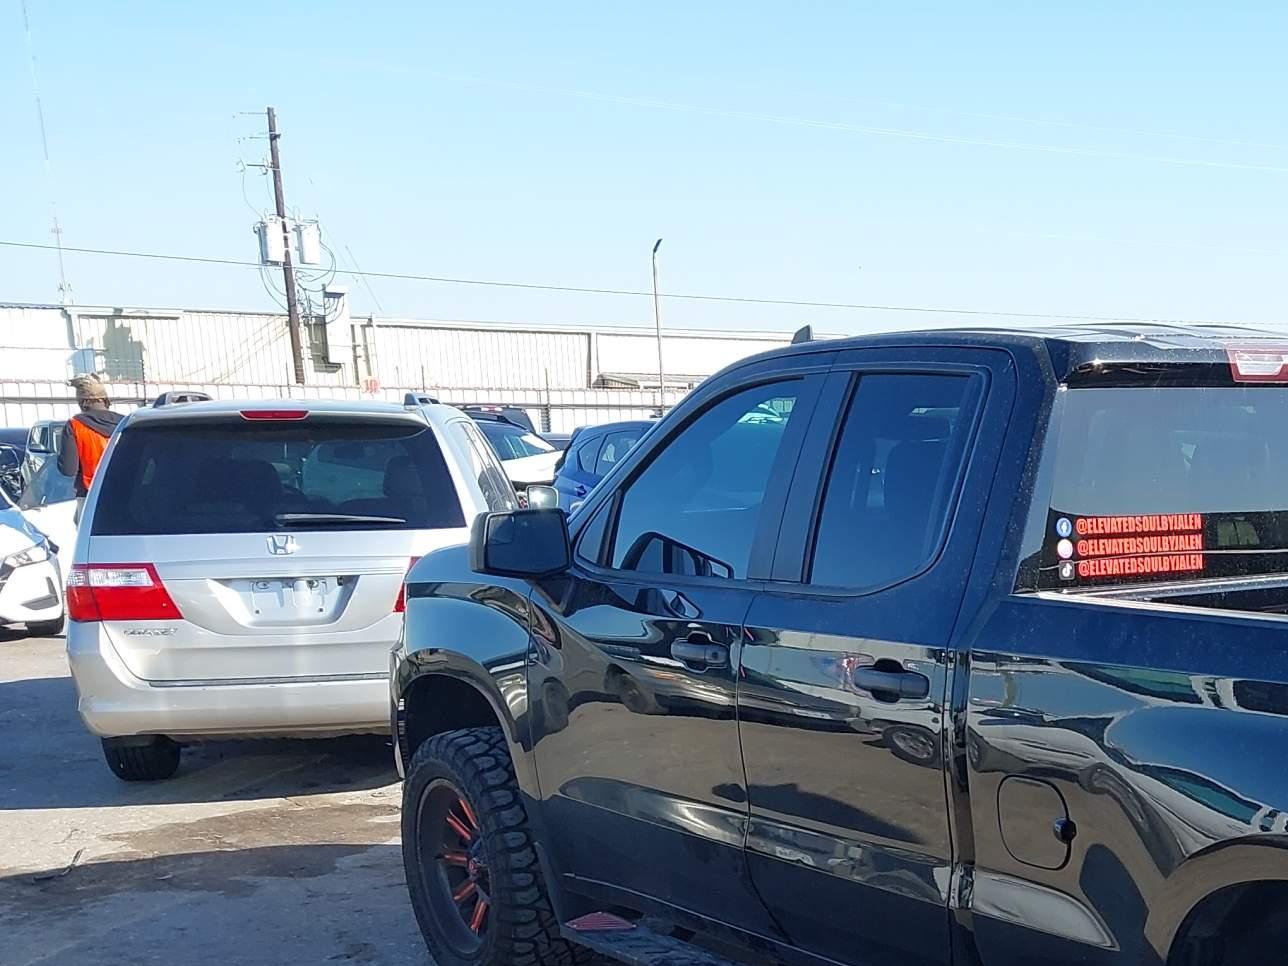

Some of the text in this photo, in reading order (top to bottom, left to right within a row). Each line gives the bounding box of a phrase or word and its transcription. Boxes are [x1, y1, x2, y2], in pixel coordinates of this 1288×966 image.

[1076, 514, 1202, 534] @ELEVATEDSOULBYJALEN
[1077, 534, 1202, 556] @ELEVATEDSOULBYJALEN
[1079, 554, 1203, 576] @ELEVATEDSOULBYJALEN
